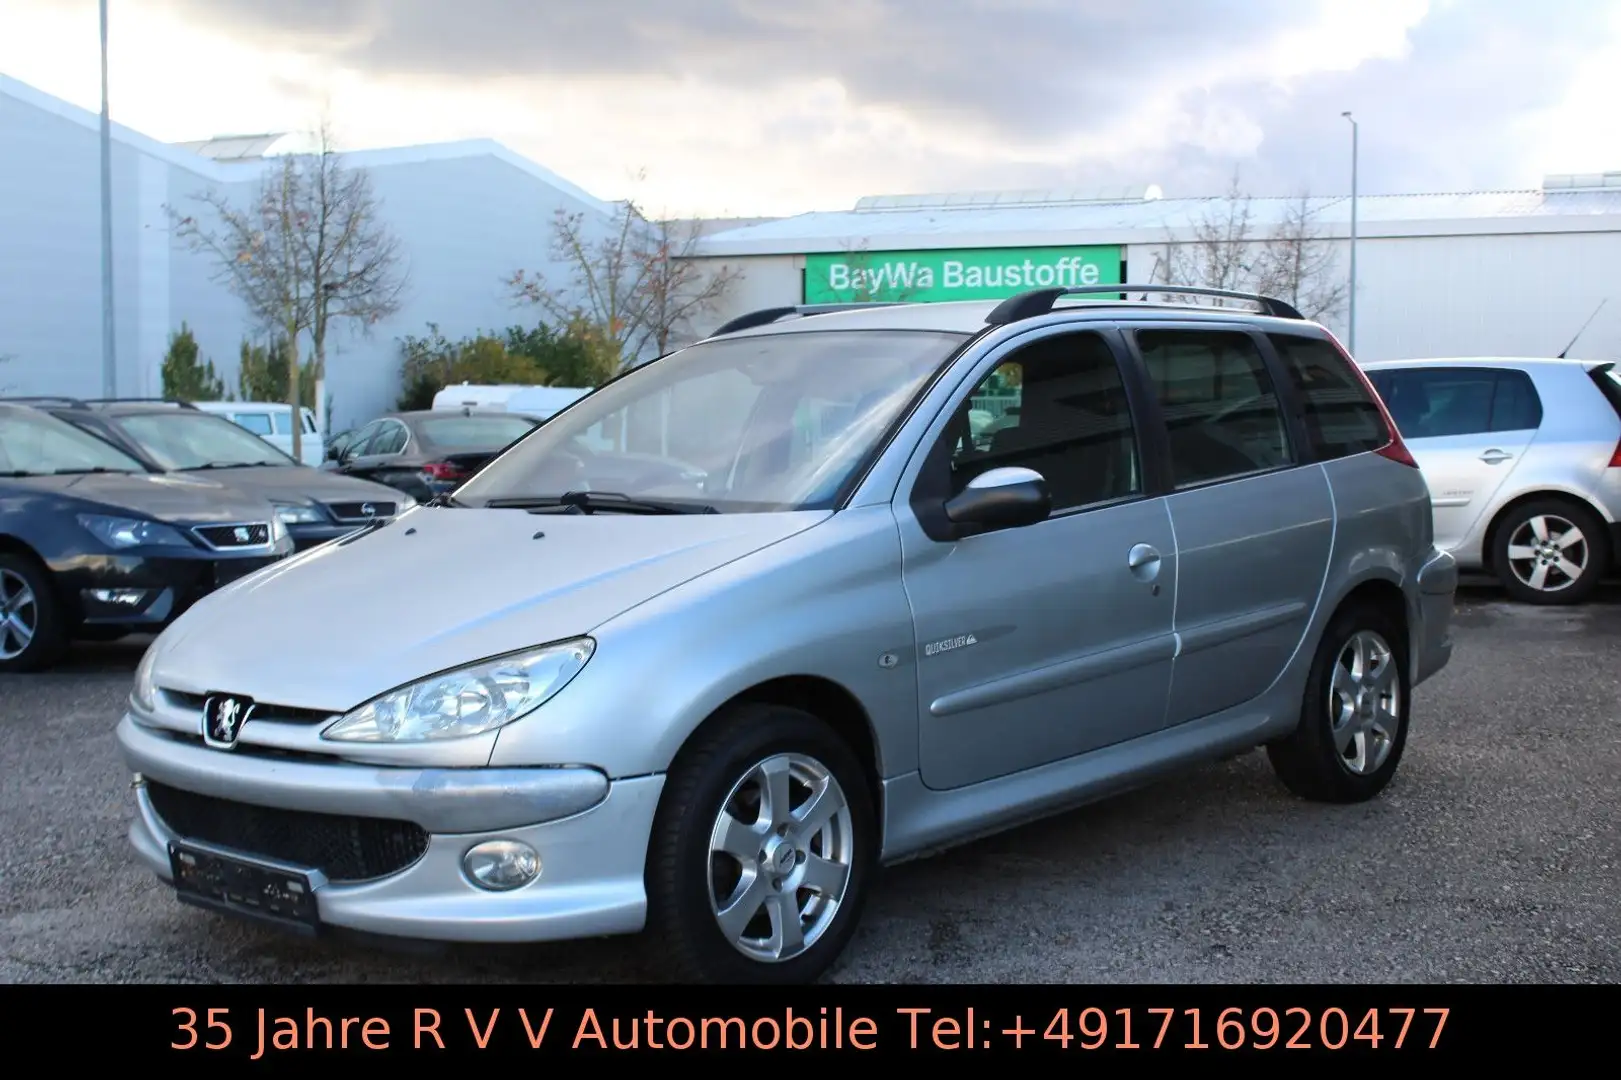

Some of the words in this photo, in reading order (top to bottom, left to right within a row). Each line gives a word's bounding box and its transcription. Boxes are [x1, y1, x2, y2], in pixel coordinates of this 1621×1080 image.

[829, 262, 933, 293] BayWa
[943, 257, 1099, 288] Baustoffe
[925, 635, 966, 655] QUIKSILVER
